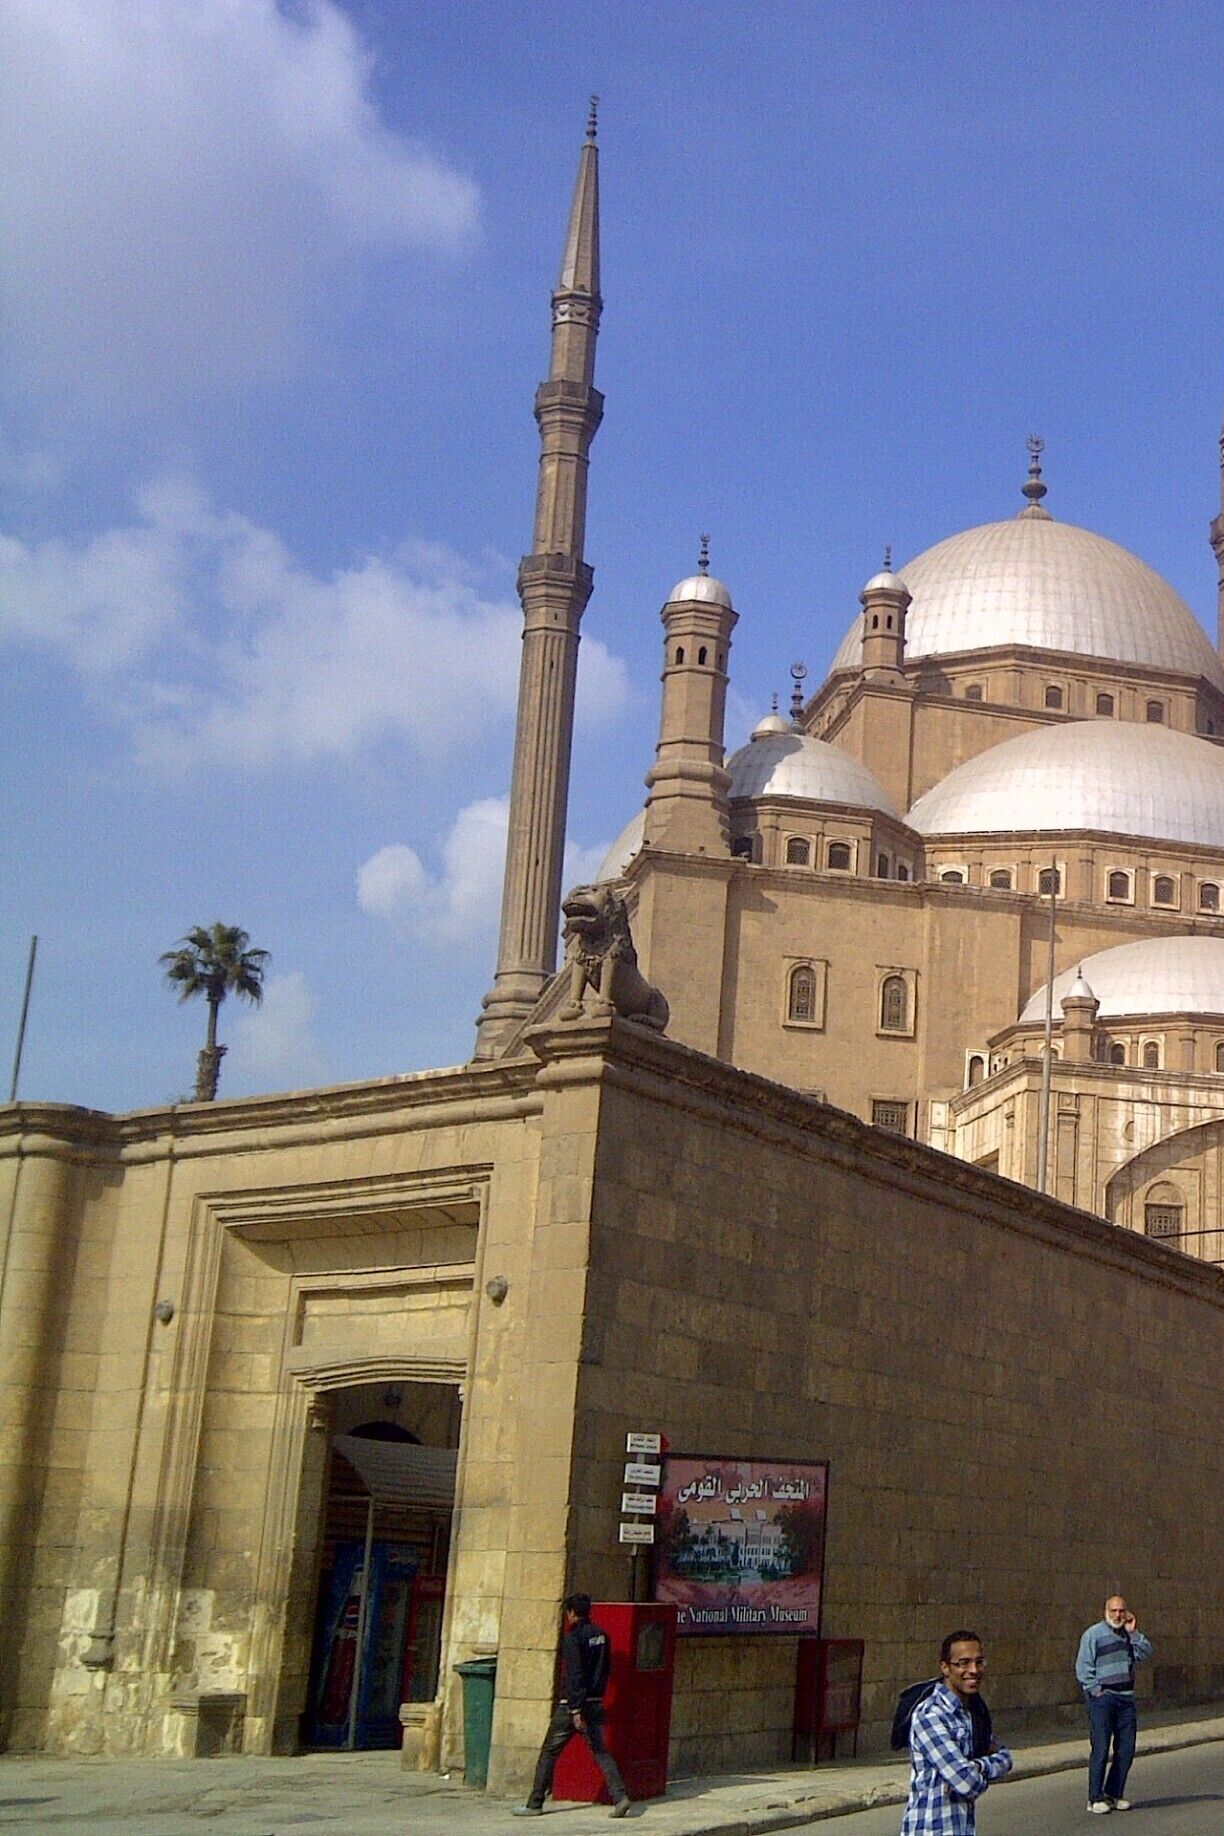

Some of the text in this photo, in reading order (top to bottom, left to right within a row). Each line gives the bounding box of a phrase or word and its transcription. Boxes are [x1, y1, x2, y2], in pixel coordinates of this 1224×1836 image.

[772, 1476, 810, 1500] المتحف
[689, 1606, 728, 1623] National
[731, 1605, 766, 1627] Military
[770, 1605, 808, 1622] Museum
